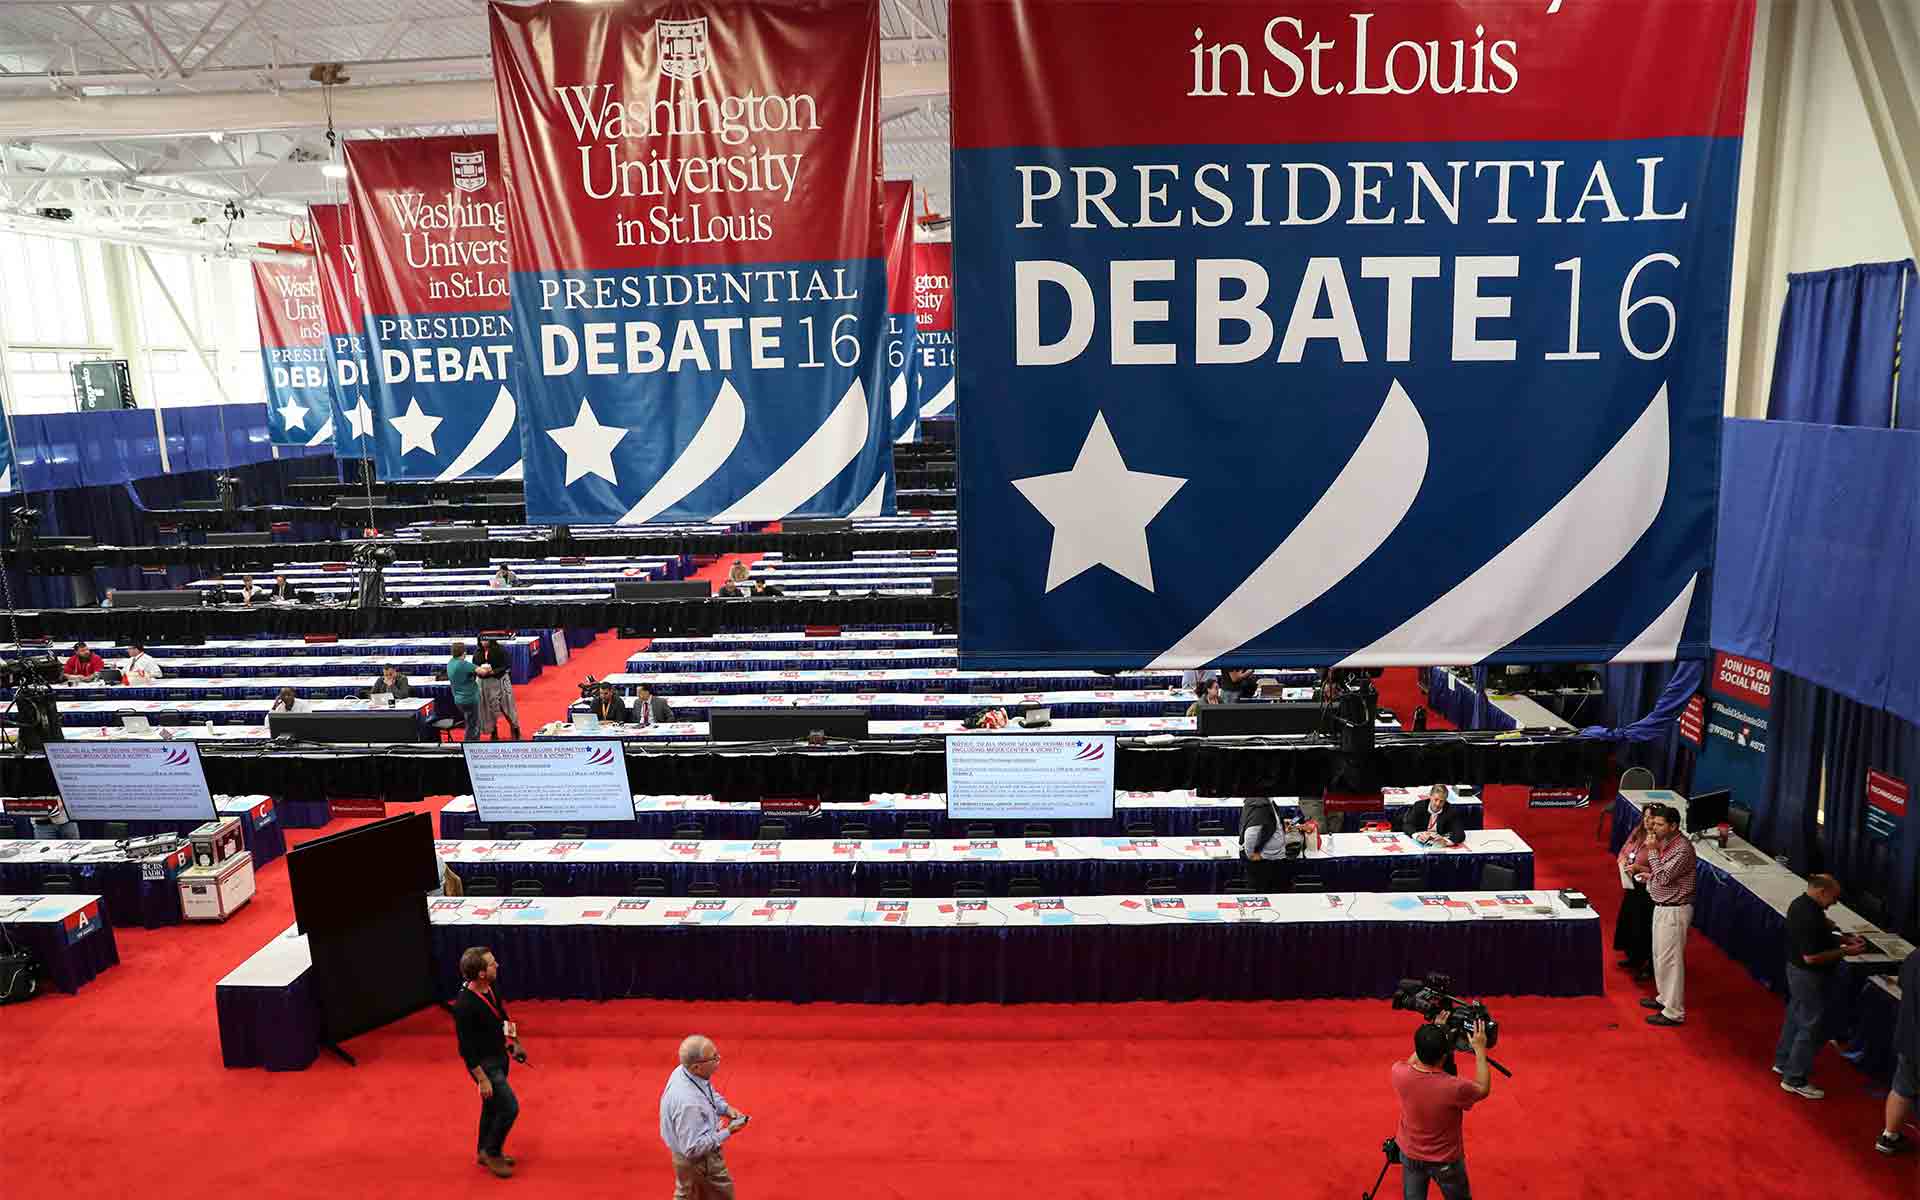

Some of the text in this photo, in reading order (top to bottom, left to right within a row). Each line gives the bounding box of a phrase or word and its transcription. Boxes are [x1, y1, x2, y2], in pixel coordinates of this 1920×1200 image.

[1187, 27, 1255, 97] in
[554, 83, 822, 146] Washington
[577, 143, 803, 201] University
[1014, 156, 1688, 229] PRESIDENTIAL
[615, 213, 648, 246] in
[429, 276, 450, 299] in
[539, 269, 858, 311] PRESIDENTIAL
[1014, 252, 1681, 366] DEBATE 16
[540, 314, 861, 376] DEBATE 16
[888, 340, 904, 368] 6
[382, 344, 513, 385] DEBAT
[1720, 670, 1749, 688] SOCIAL
[1722, 659, 1771, 682] JOIN US ON
[260, 804, 268, 818] C
[178, 852, 186, 867] B
[80, 911, 89, 929] A
